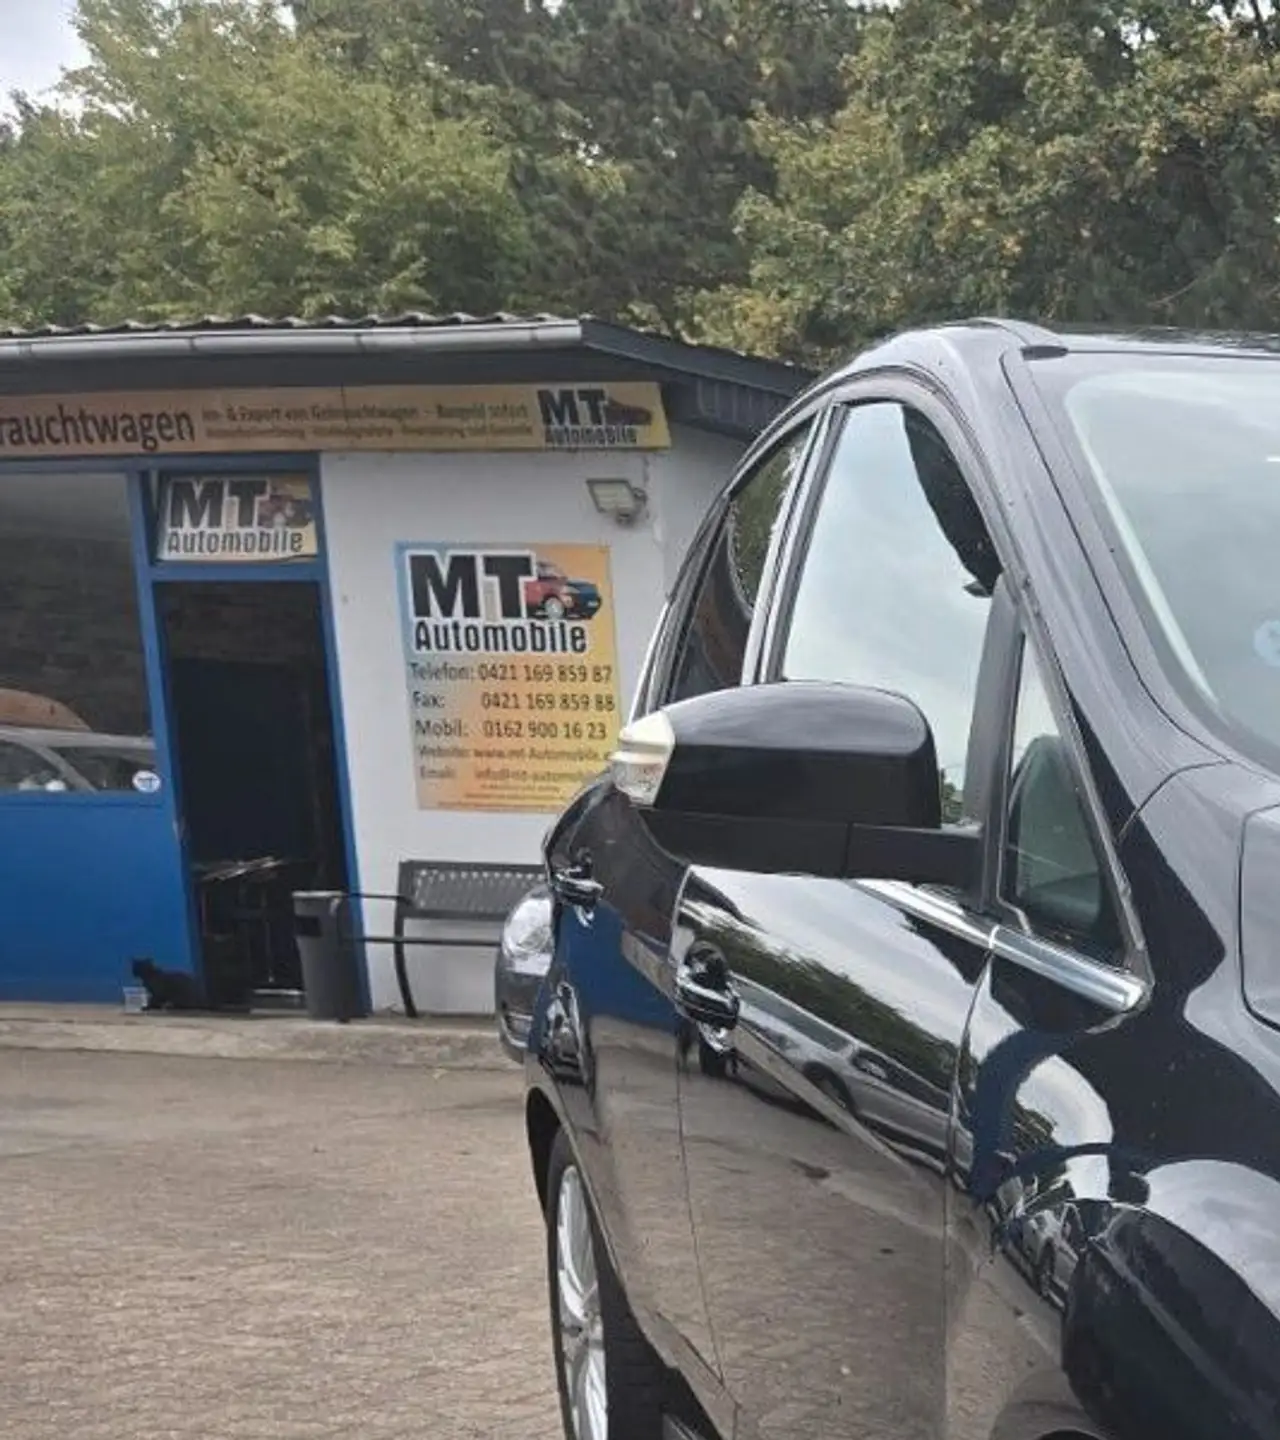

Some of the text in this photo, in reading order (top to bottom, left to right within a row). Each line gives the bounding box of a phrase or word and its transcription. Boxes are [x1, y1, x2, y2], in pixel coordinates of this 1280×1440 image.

[537, 388, 605, 426] MT
[170, 479, 268, 529] MT
[167, 530, 304, 554] Automobile
[409, 554, 532, 619] MT
[415, 620, 587, 654] Automobile
[410, 662, 614, 683] Telefon: 0421 169 859 87
[412, 691, 446, 709] Fax:
[481, 691, 520, 710] 0421
[526, 692, 555, 710] 169
[559, 693, 590, 711] 859
[414, 719, 608, 740] Mobil: 0162 900 16 23
